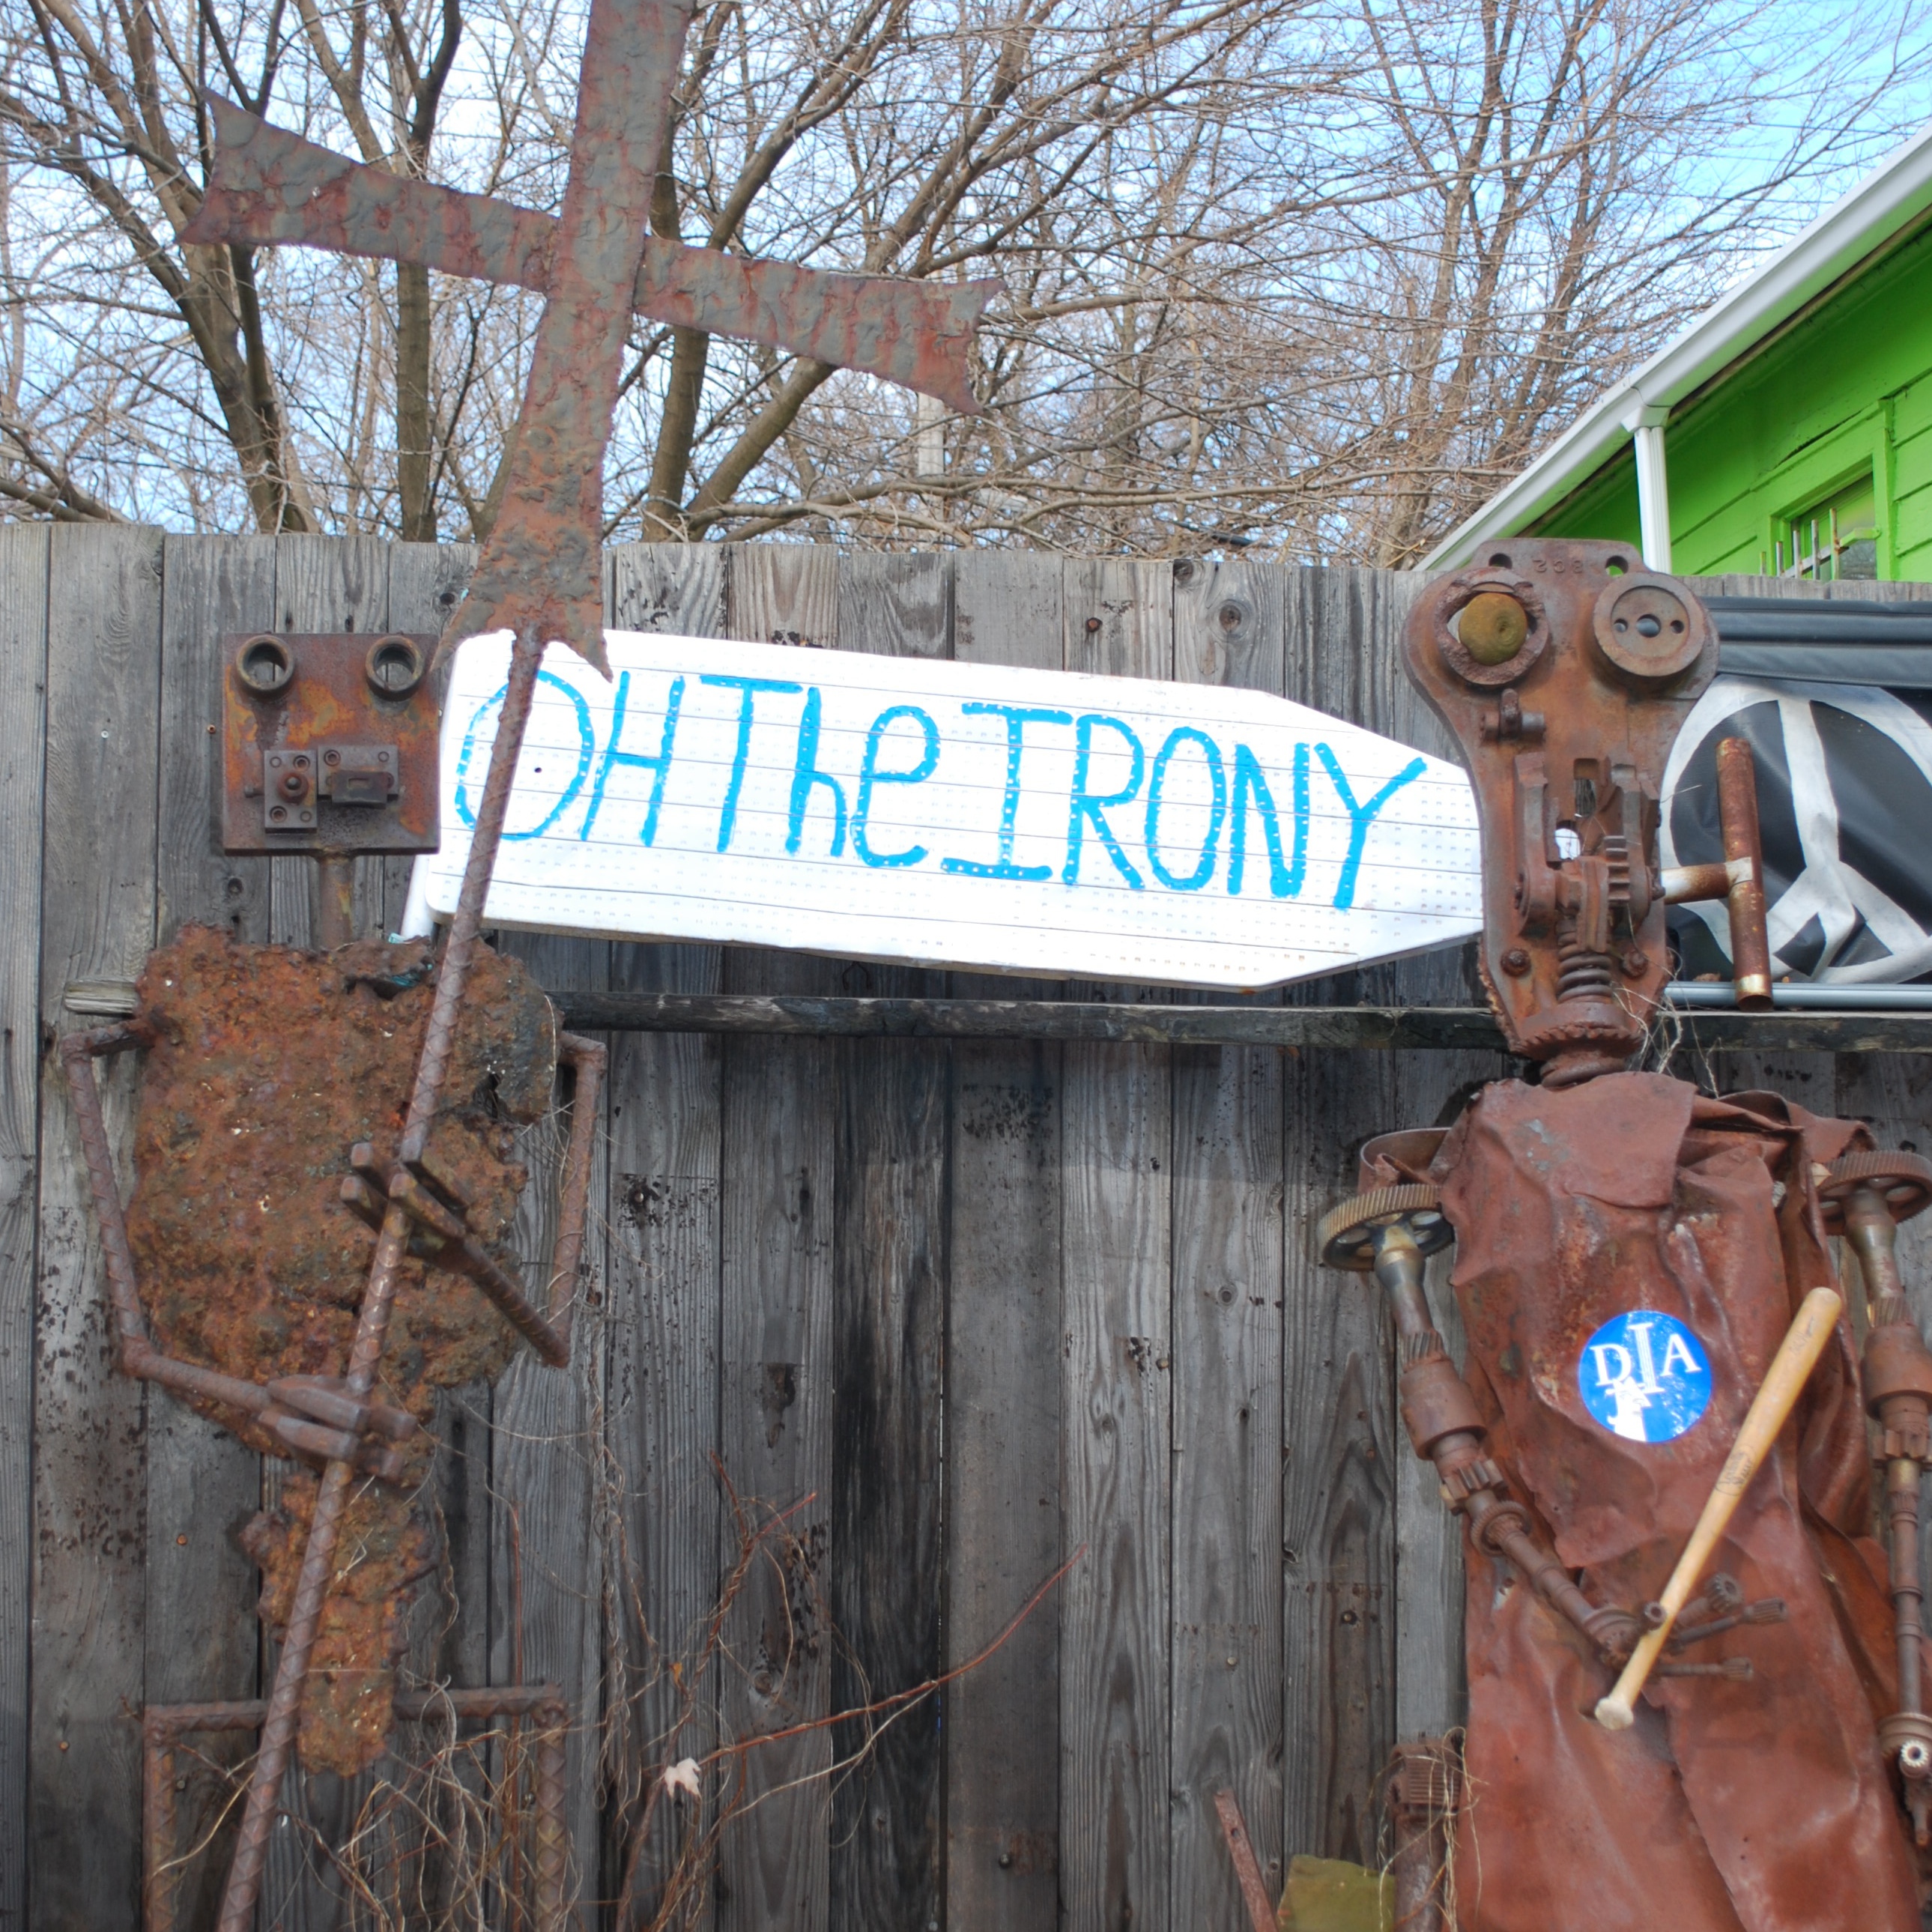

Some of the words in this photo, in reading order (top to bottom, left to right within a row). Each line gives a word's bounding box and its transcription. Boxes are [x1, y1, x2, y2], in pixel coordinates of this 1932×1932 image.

[454, 670, 685, 847] OH
[699, 673, 941, 868] The
[940, 702, 1427, 912] IRONY
[1589, 1321, 1702, 1394] DIA
